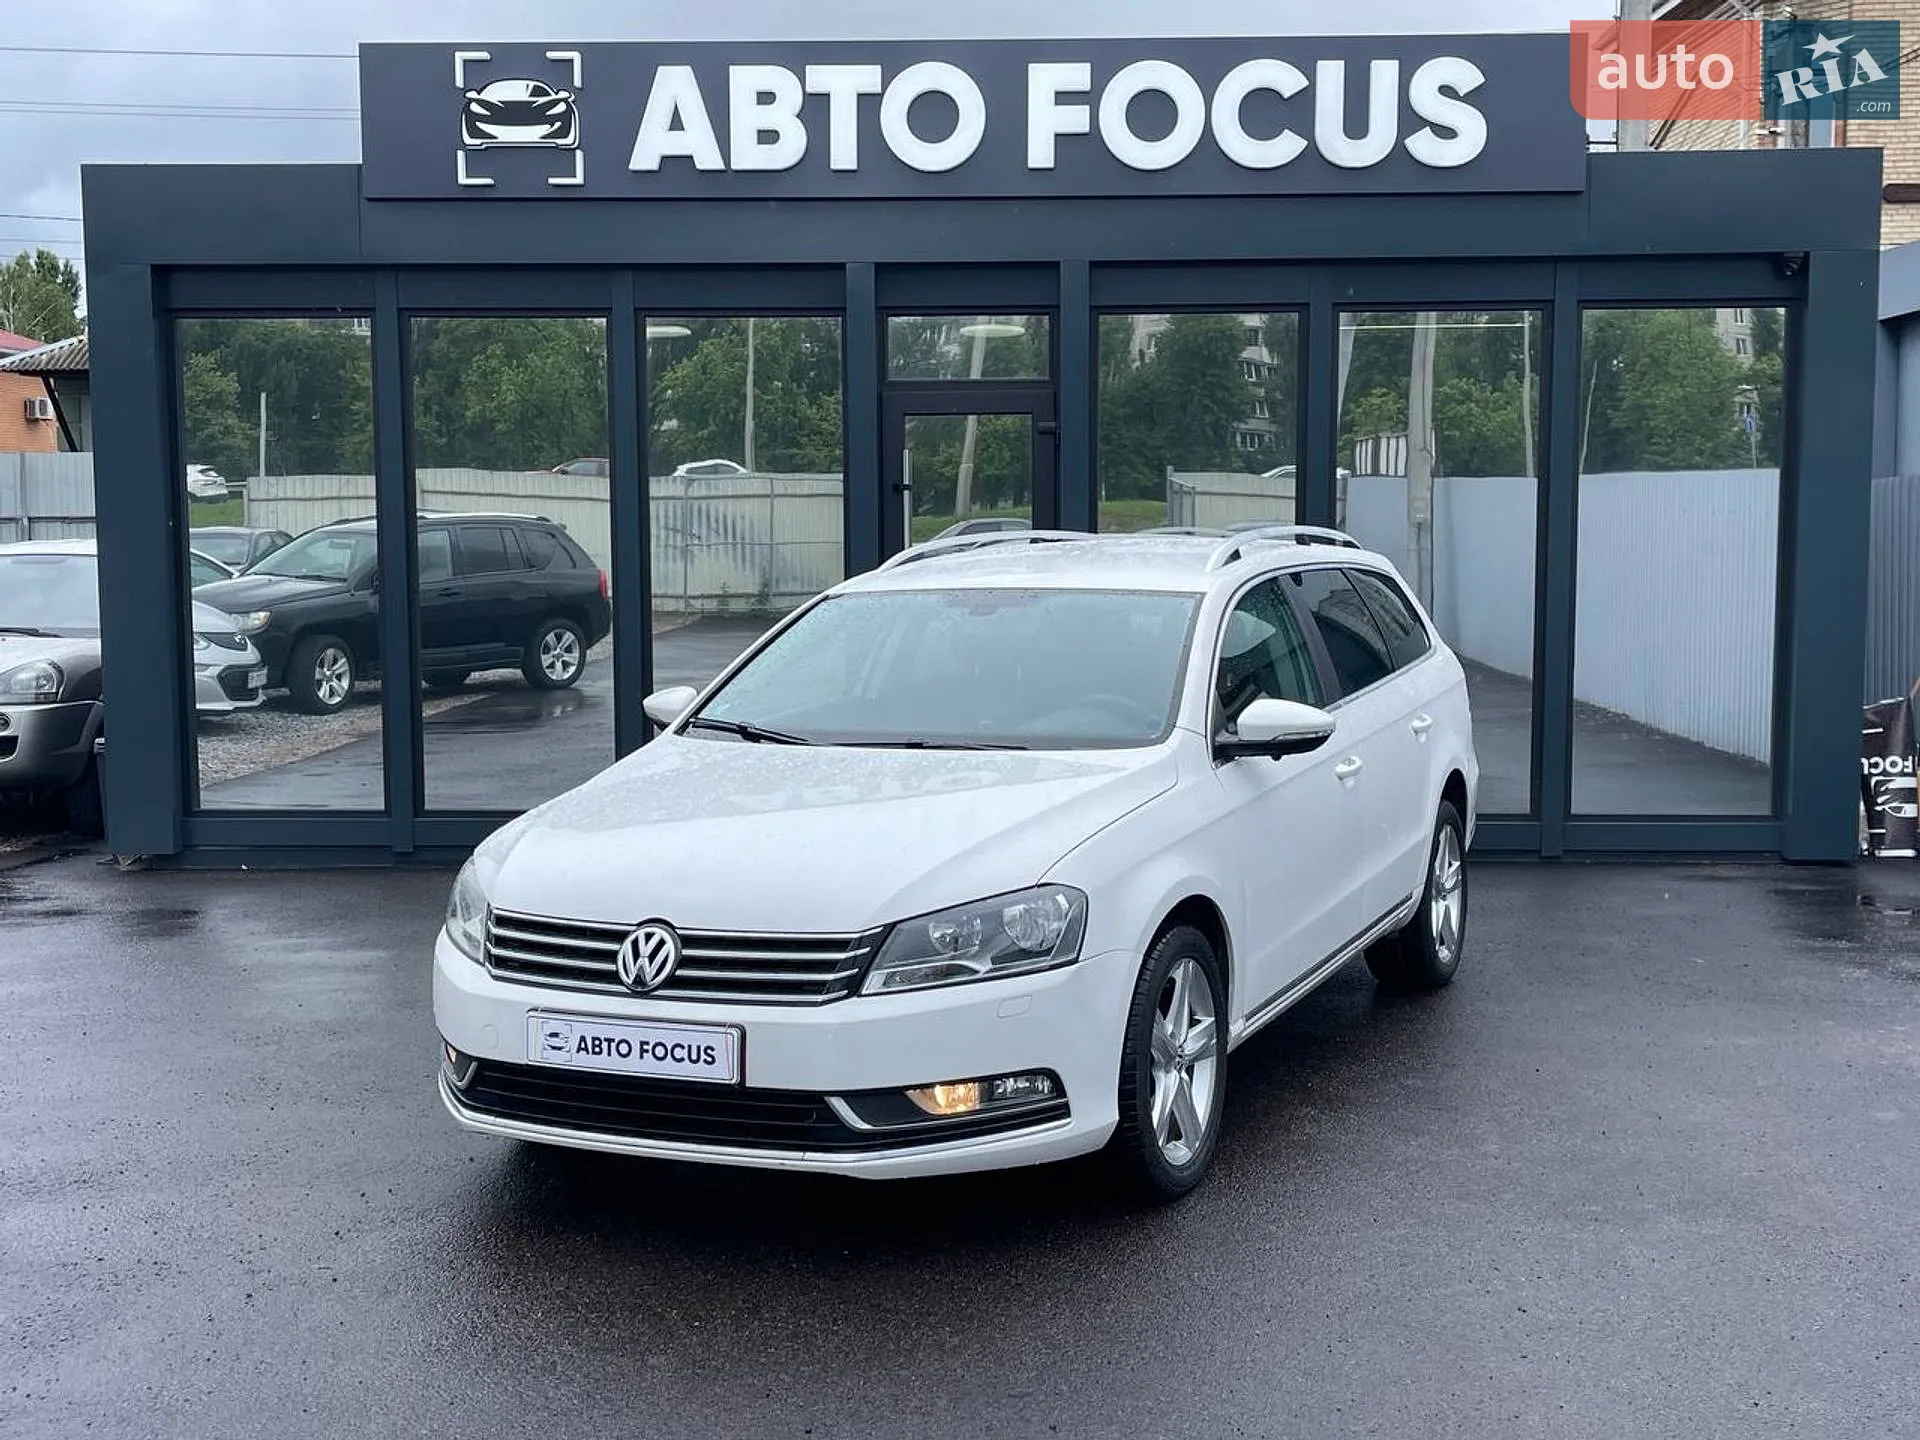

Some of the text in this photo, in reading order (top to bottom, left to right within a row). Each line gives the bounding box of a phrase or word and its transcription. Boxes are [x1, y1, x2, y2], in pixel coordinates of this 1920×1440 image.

[628, 56, 1487, 172] АВТО FOCUS
[576, 1035, 716, 1065] АВТО FOCUS
